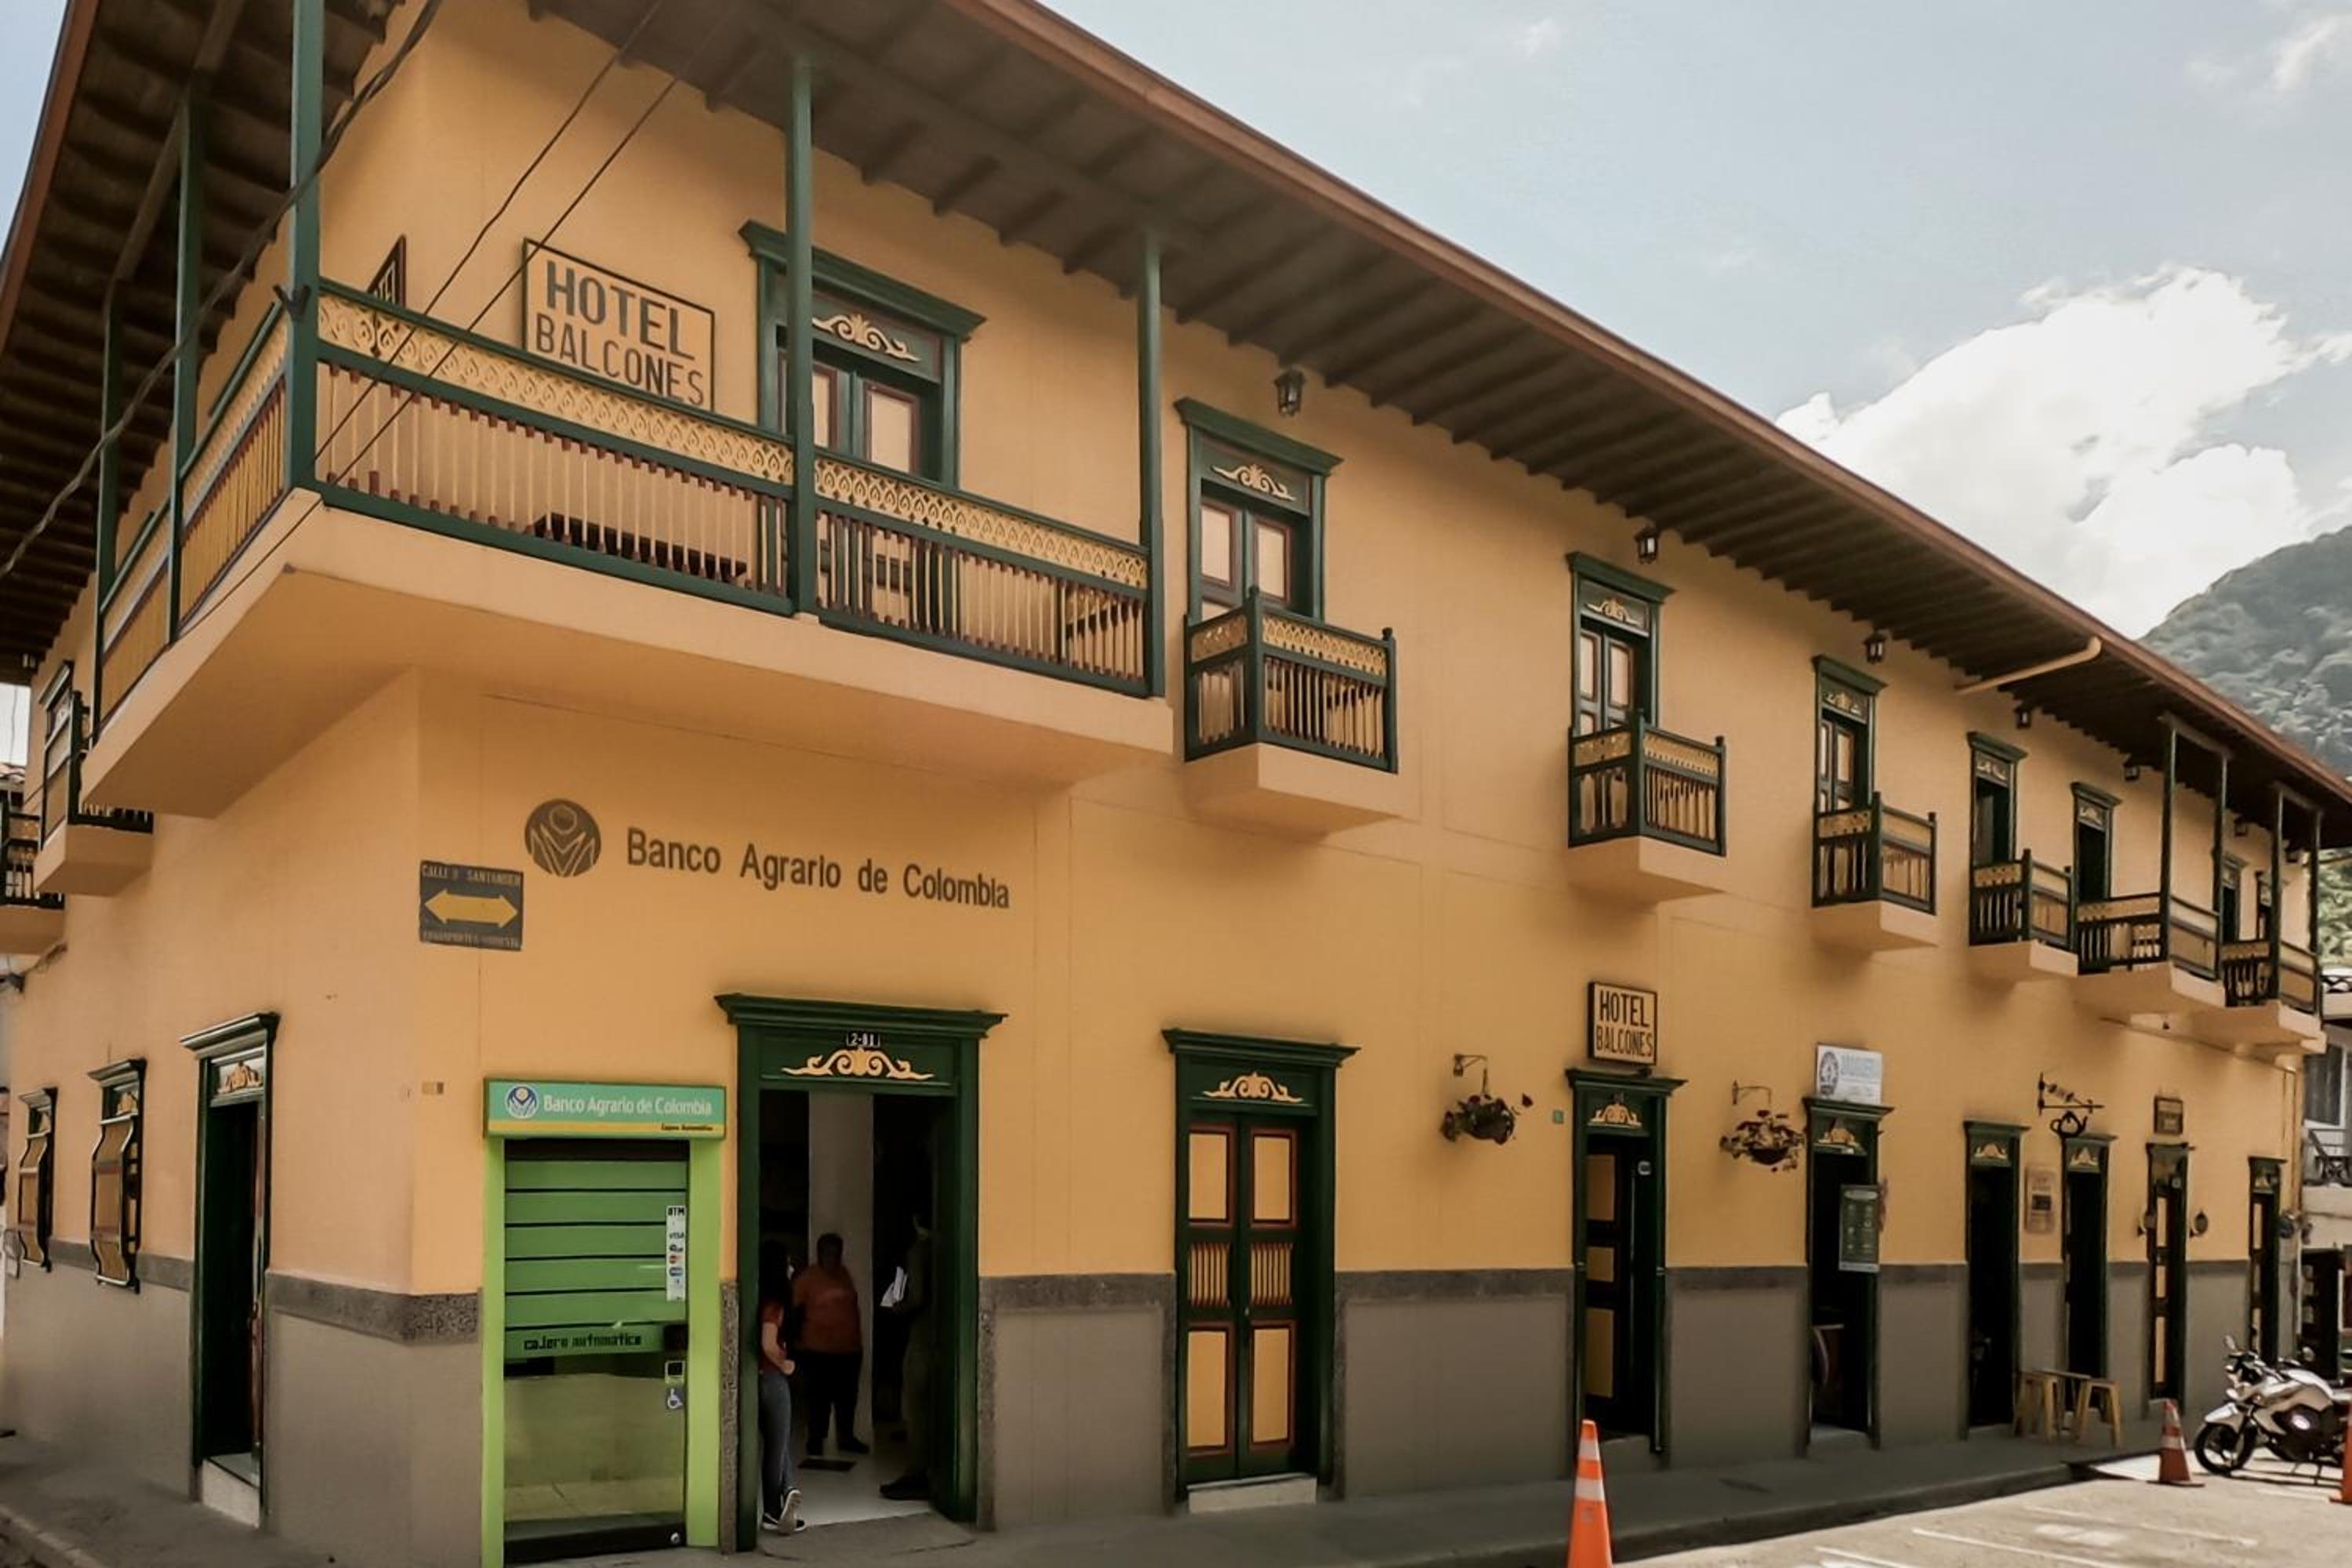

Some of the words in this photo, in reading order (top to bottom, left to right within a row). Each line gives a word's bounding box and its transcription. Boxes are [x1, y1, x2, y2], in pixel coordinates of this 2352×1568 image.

[546, 260, 695, 361] HOTEL
[536, 312, 704, 406] BALCONES
[627, 827, 720, 873] Banco
[739, 843, 841, 891] Agrario
[858, 858, 888, 894] de
[903, 863, 1009, 909] Colombia
[1600, 989, 1650, 1027] HOTEL
[1596, 1024, 1653, 1057] BALCONES
[543, 1094, 585, 1112] Banco
[587, 1096, 634, 1116] Agrario
[637, 1098, 652, 1114] de
[655, 1097, 712, 1116] Colombia
